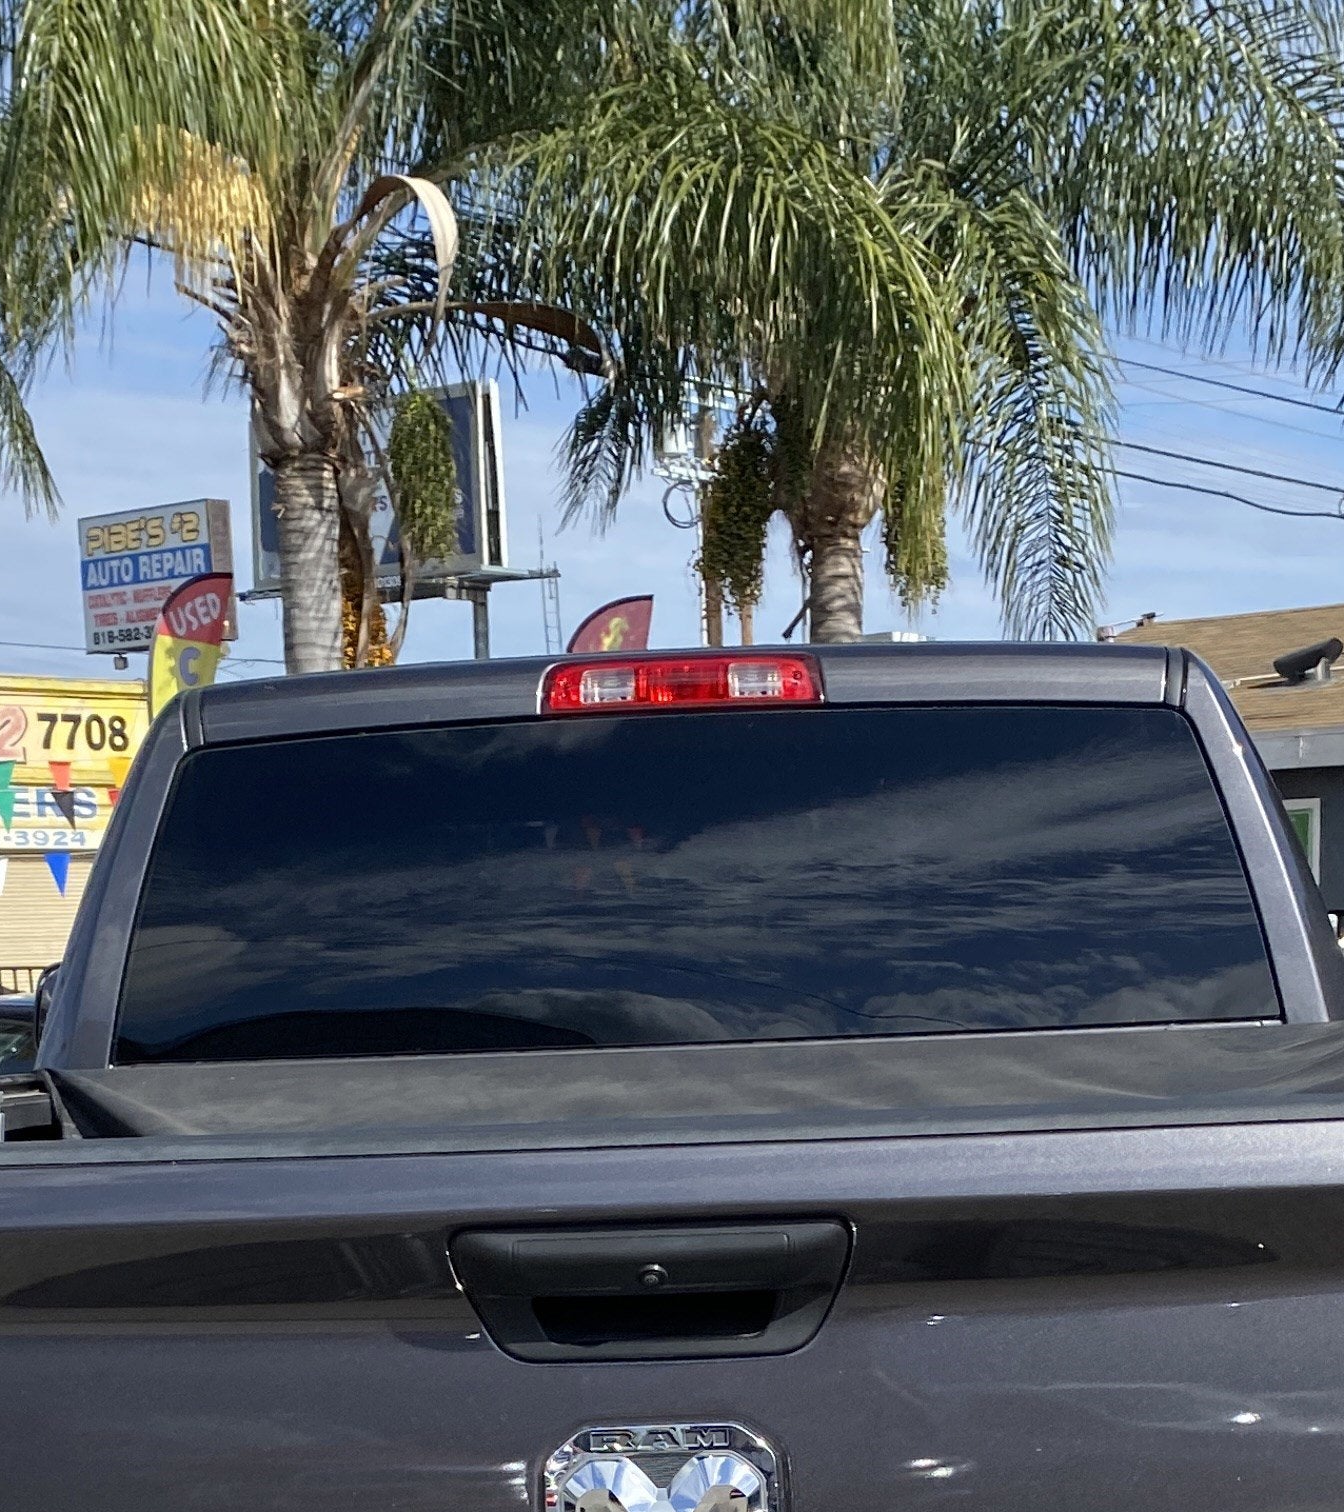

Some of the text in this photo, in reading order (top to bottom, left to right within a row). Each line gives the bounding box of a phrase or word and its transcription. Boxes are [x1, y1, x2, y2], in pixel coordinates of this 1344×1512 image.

[86, 516, 165, 557] PIBE'S
[87, 547, 206, 588] AUTO REPAIR
[169, 593, 222, 636] USED
[37, 713, 129, 752] 7708
[589, 1427, 730, 1452] RAM
